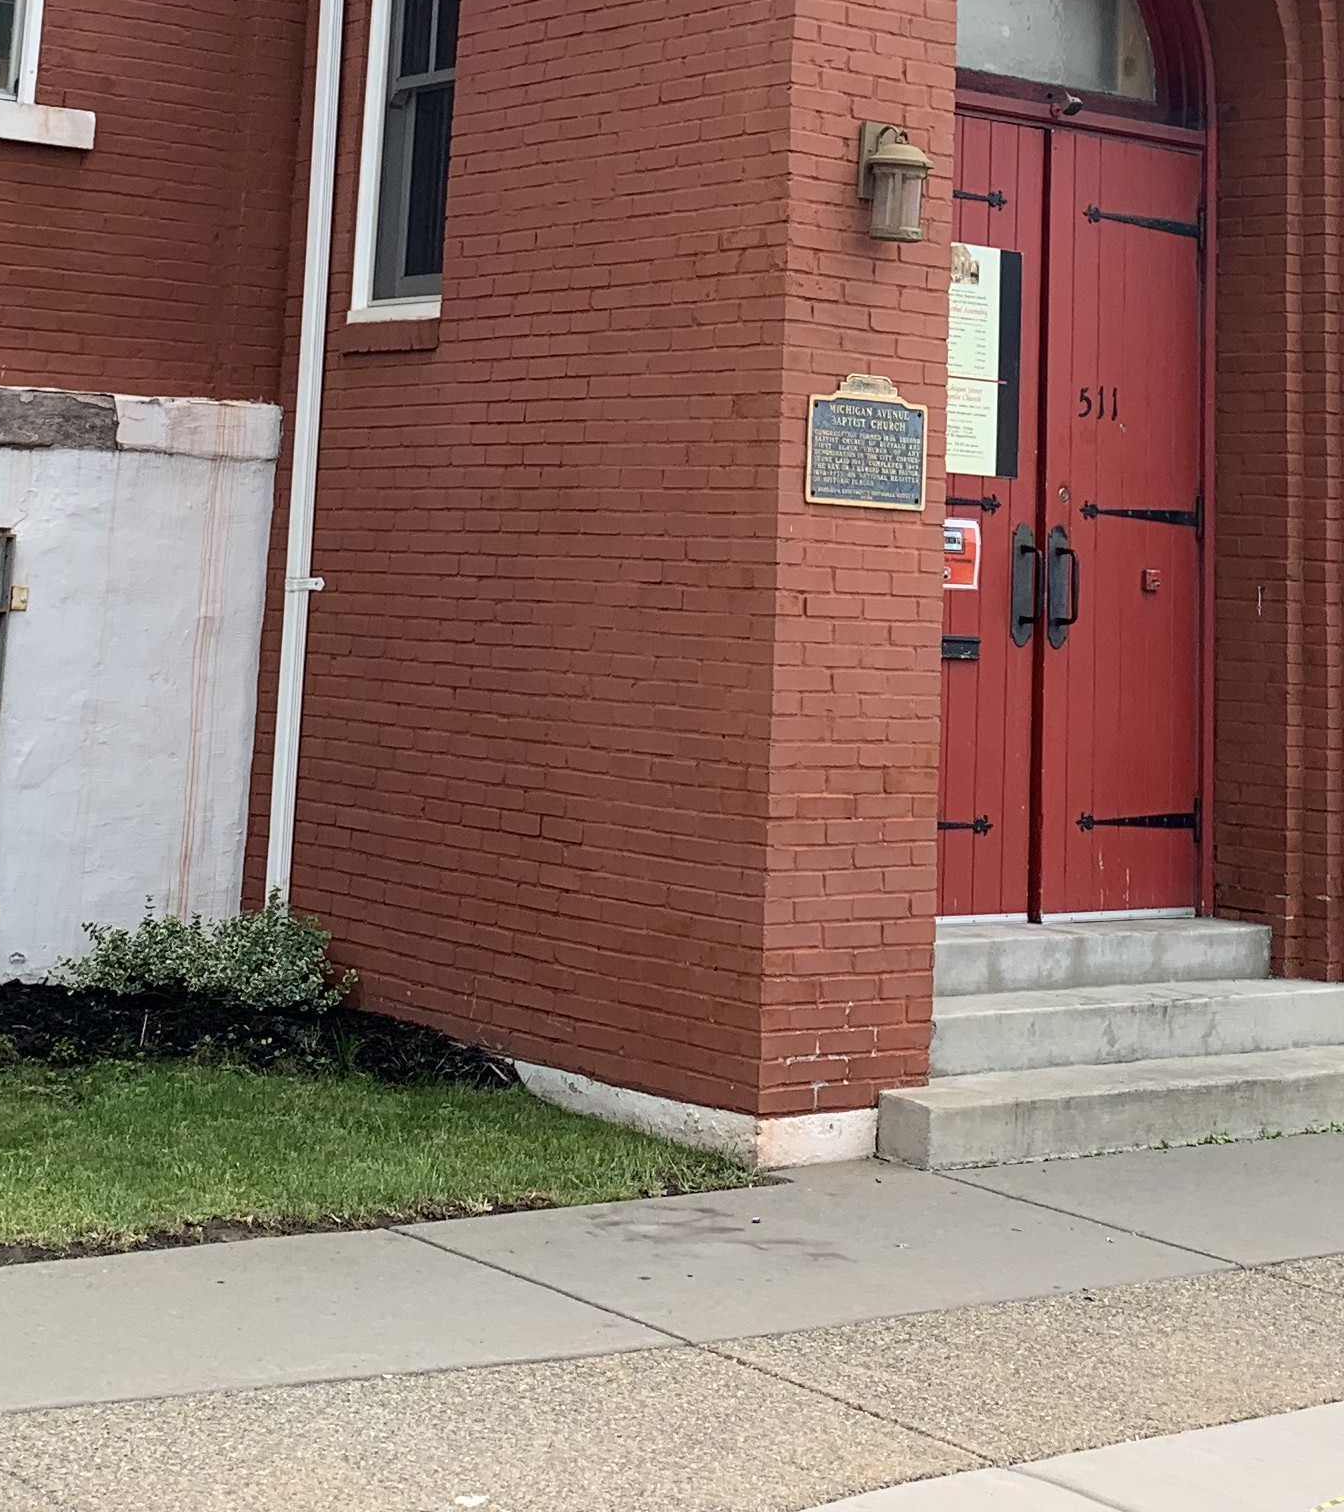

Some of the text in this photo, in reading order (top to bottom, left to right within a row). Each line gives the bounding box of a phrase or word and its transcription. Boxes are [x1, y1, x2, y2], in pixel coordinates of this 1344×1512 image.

[1078, 385, 1118, 421] 511
[830, 404, 910, 421] MICHIGAN AVENUE
[832, 417, 906, 432] BAPTIST CHURCH
